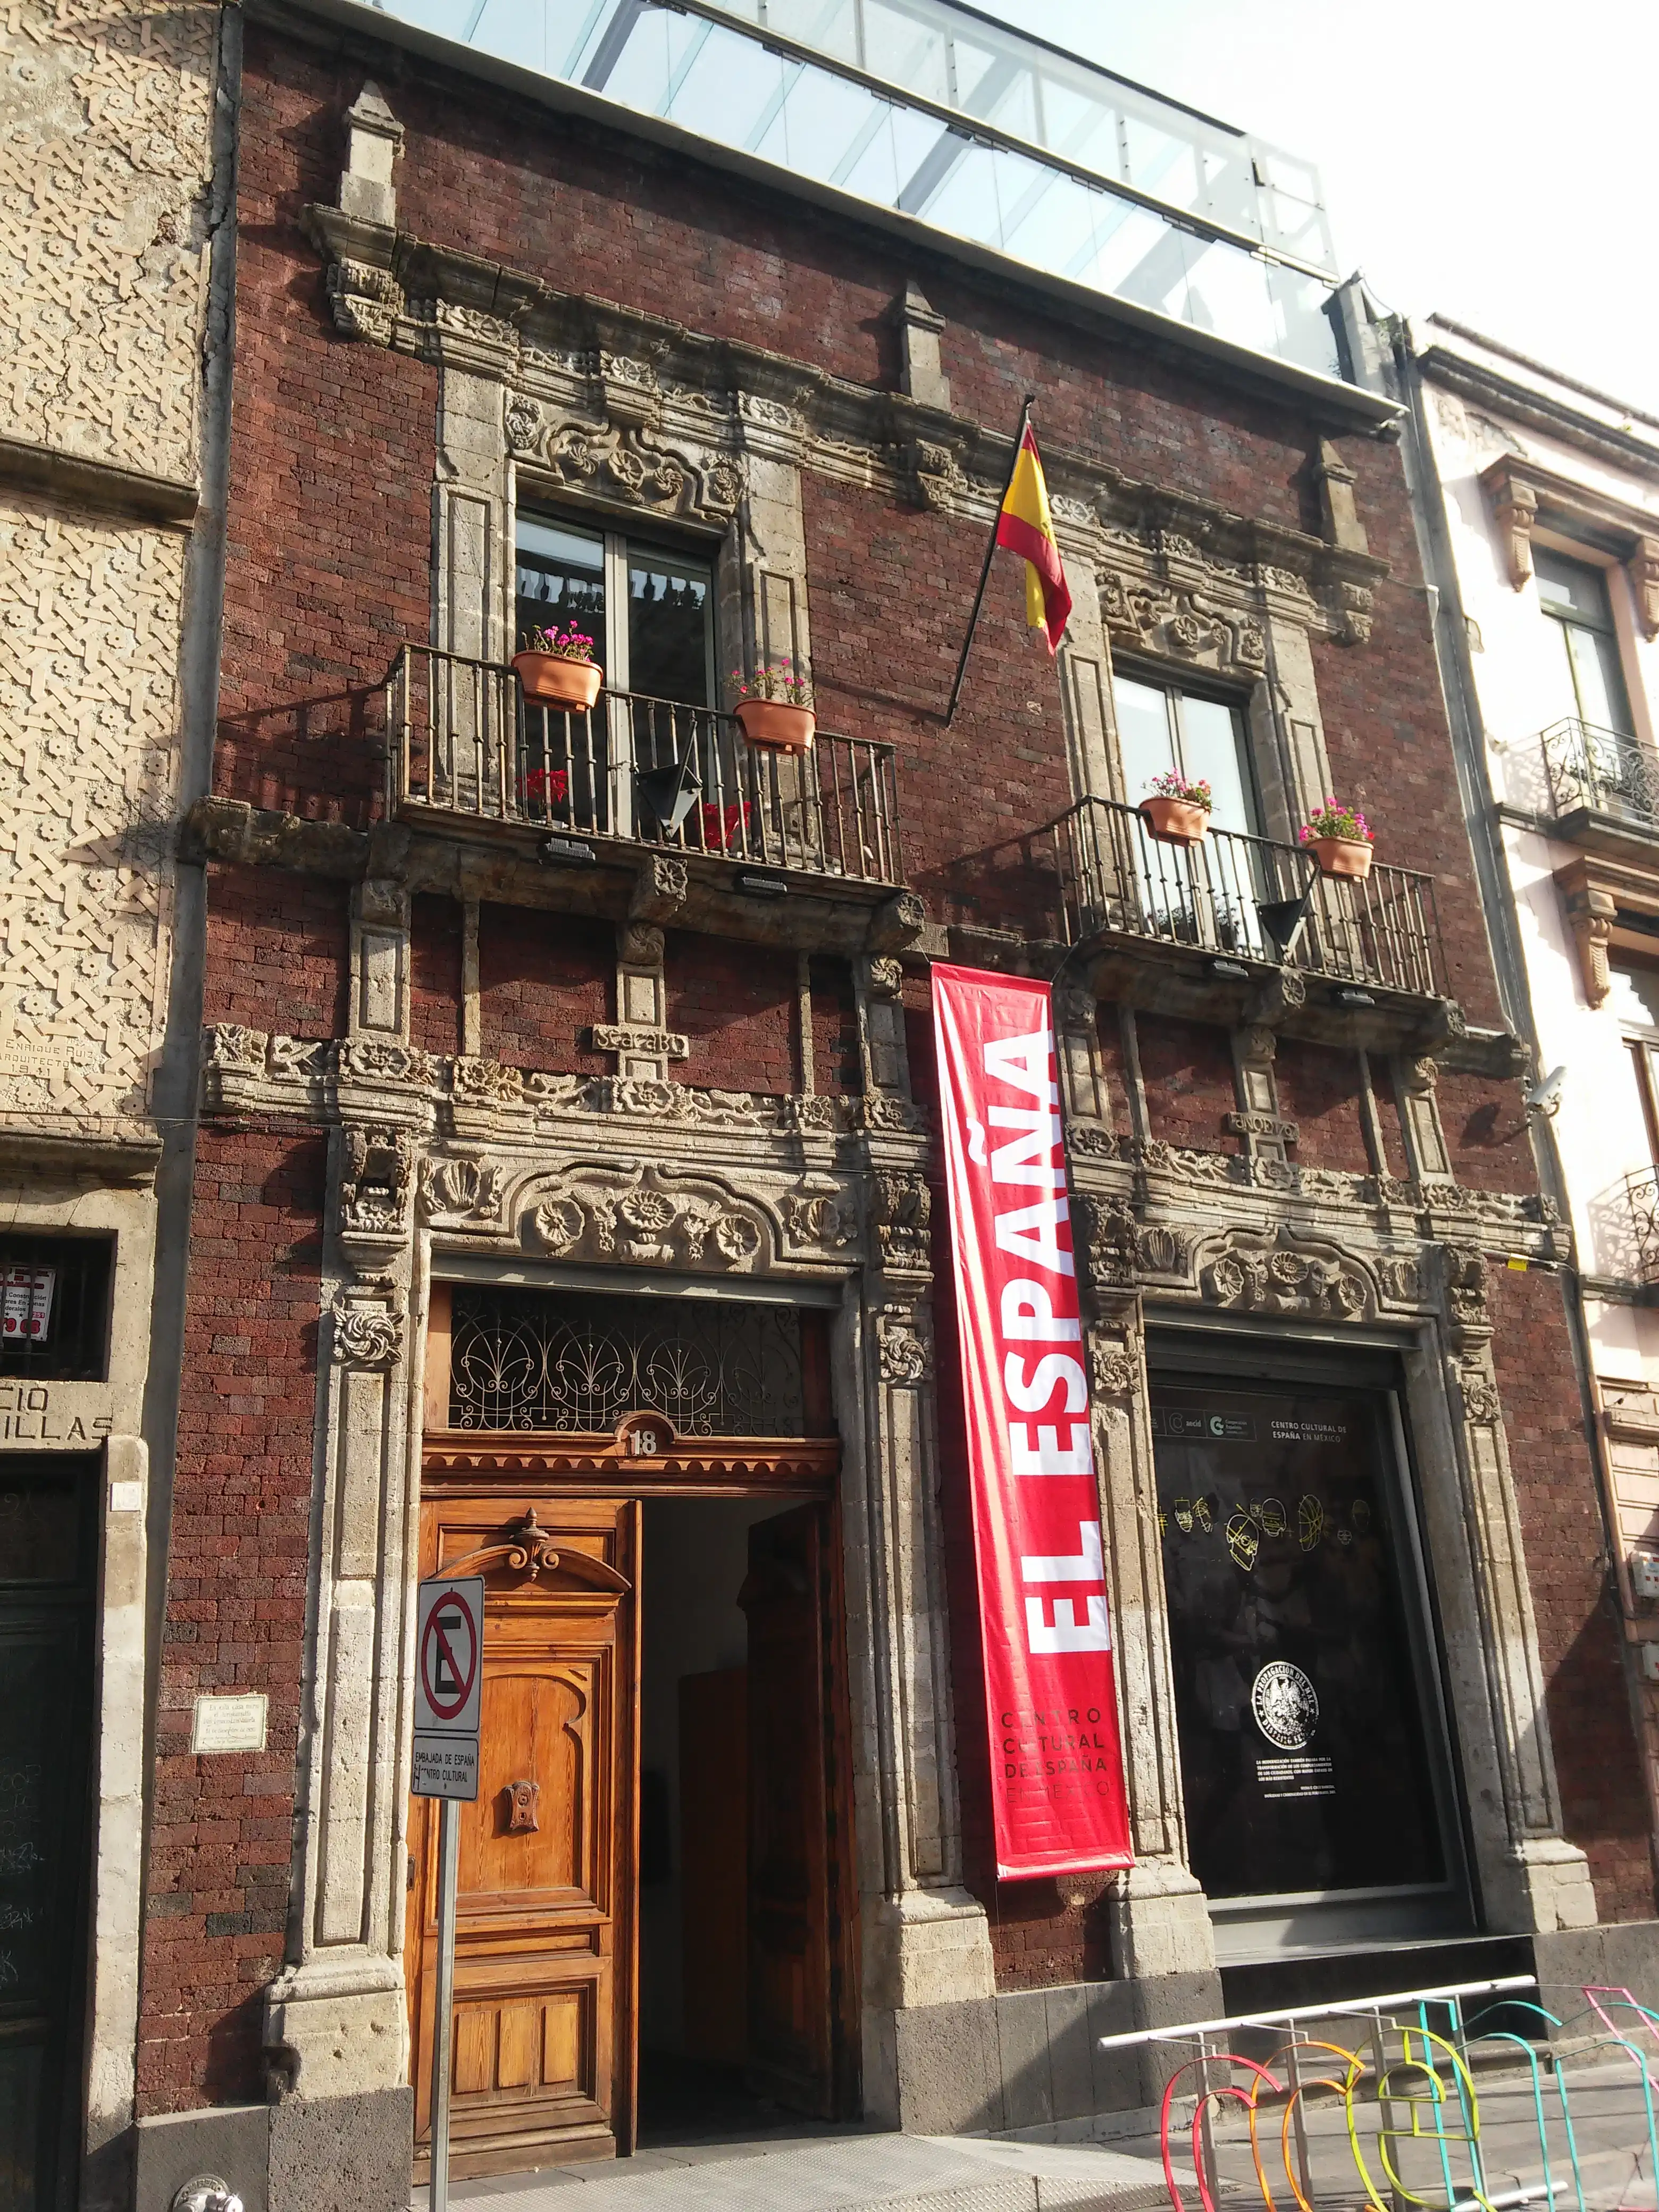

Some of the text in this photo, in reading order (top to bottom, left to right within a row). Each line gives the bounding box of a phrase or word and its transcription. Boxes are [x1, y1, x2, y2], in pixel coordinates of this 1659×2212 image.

[6, 1038, 93, 1059] ENRIQUE RUIZ
[967, 1029, 1094, 1476] ESPAÑA
[1271, 1421, 1298, 1429] CENTRO
[1301, 1423, 1336, 1432] CULTURAL
[630, 1430, 657, 1455] 18
[1272, 1431, 1301, 1440] ESPAÑA
[1257, 1665, 1295, 1692] PROPAGACIÓN
[1295, 1672, 1307, 1687] DEL
[1304, 1687, 1314, 1705] MAL
[415, 1752, 475, 1766] EMBAJADA DE ESPAÑA
[442, 1770, 467, 1782] CULTURAL
[1006, 1763, 1028, 1779] DE
